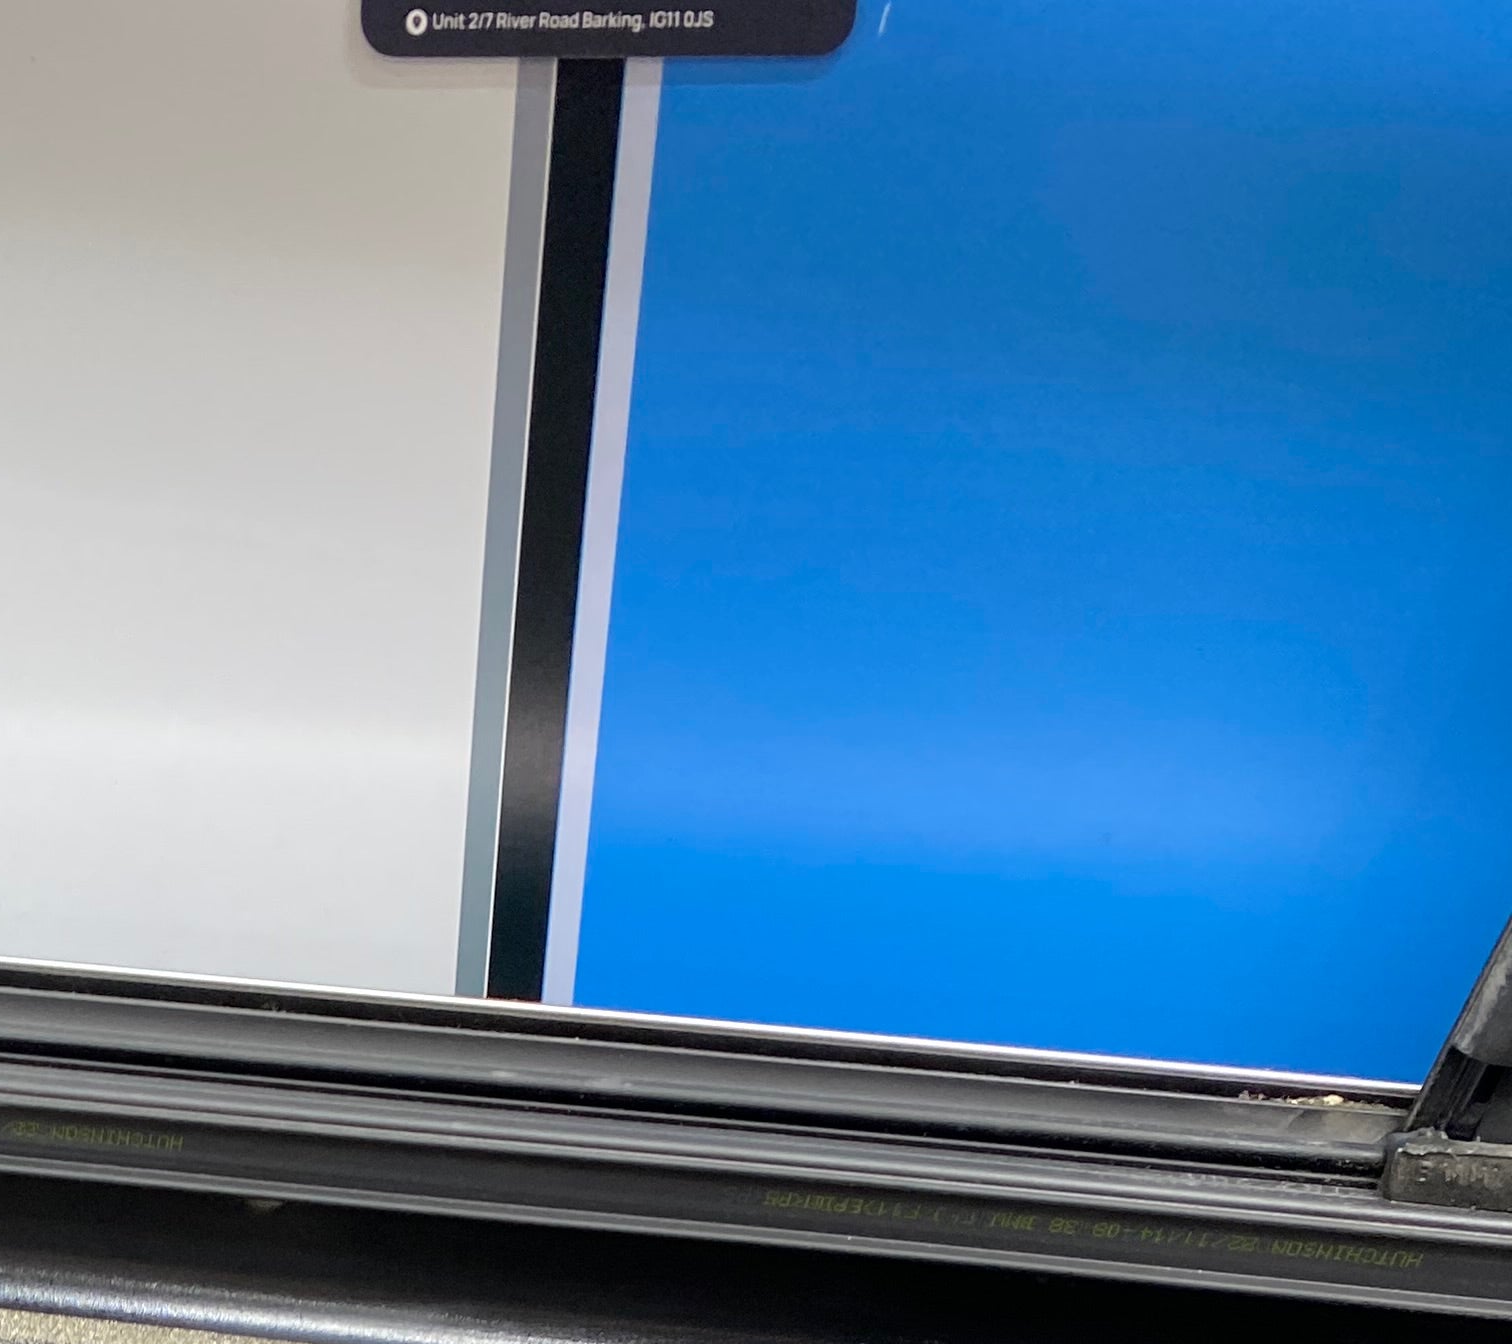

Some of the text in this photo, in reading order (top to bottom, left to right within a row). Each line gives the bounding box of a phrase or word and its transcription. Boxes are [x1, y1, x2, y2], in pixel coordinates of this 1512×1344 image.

[432, 13, 465, 30] Unit
[468, 12, 493, 30] 2/7
[496, 12, 536, 29] River
[539, 12, 579, 29] Road
[649, 10, 680, 28] IG11
[1271, 1238, 1424, 1268] HUTCHINSON
